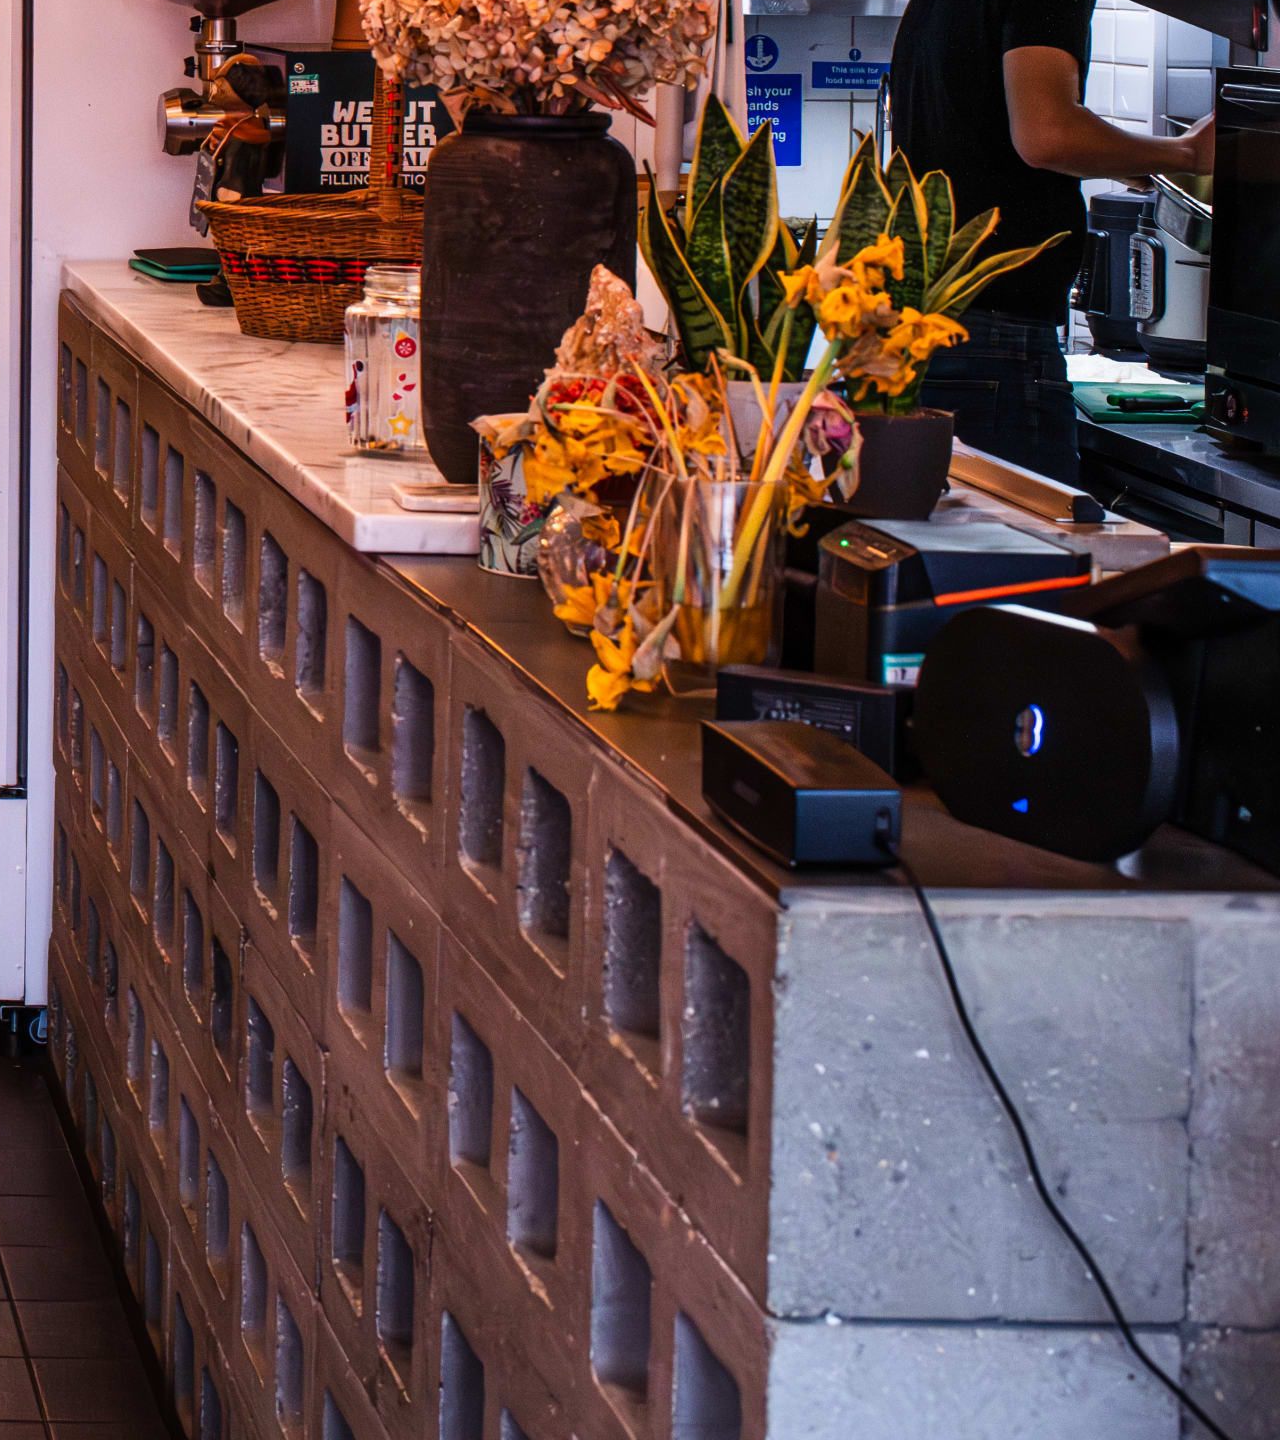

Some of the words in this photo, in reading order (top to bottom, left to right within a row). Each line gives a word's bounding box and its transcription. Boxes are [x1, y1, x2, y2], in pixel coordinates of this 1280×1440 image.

[746, 85, 762, 97] sh
[764, 87, 792, 99] your
[748, 100, 780, 111] ands
[320, 124, 437, 146] BUTER
